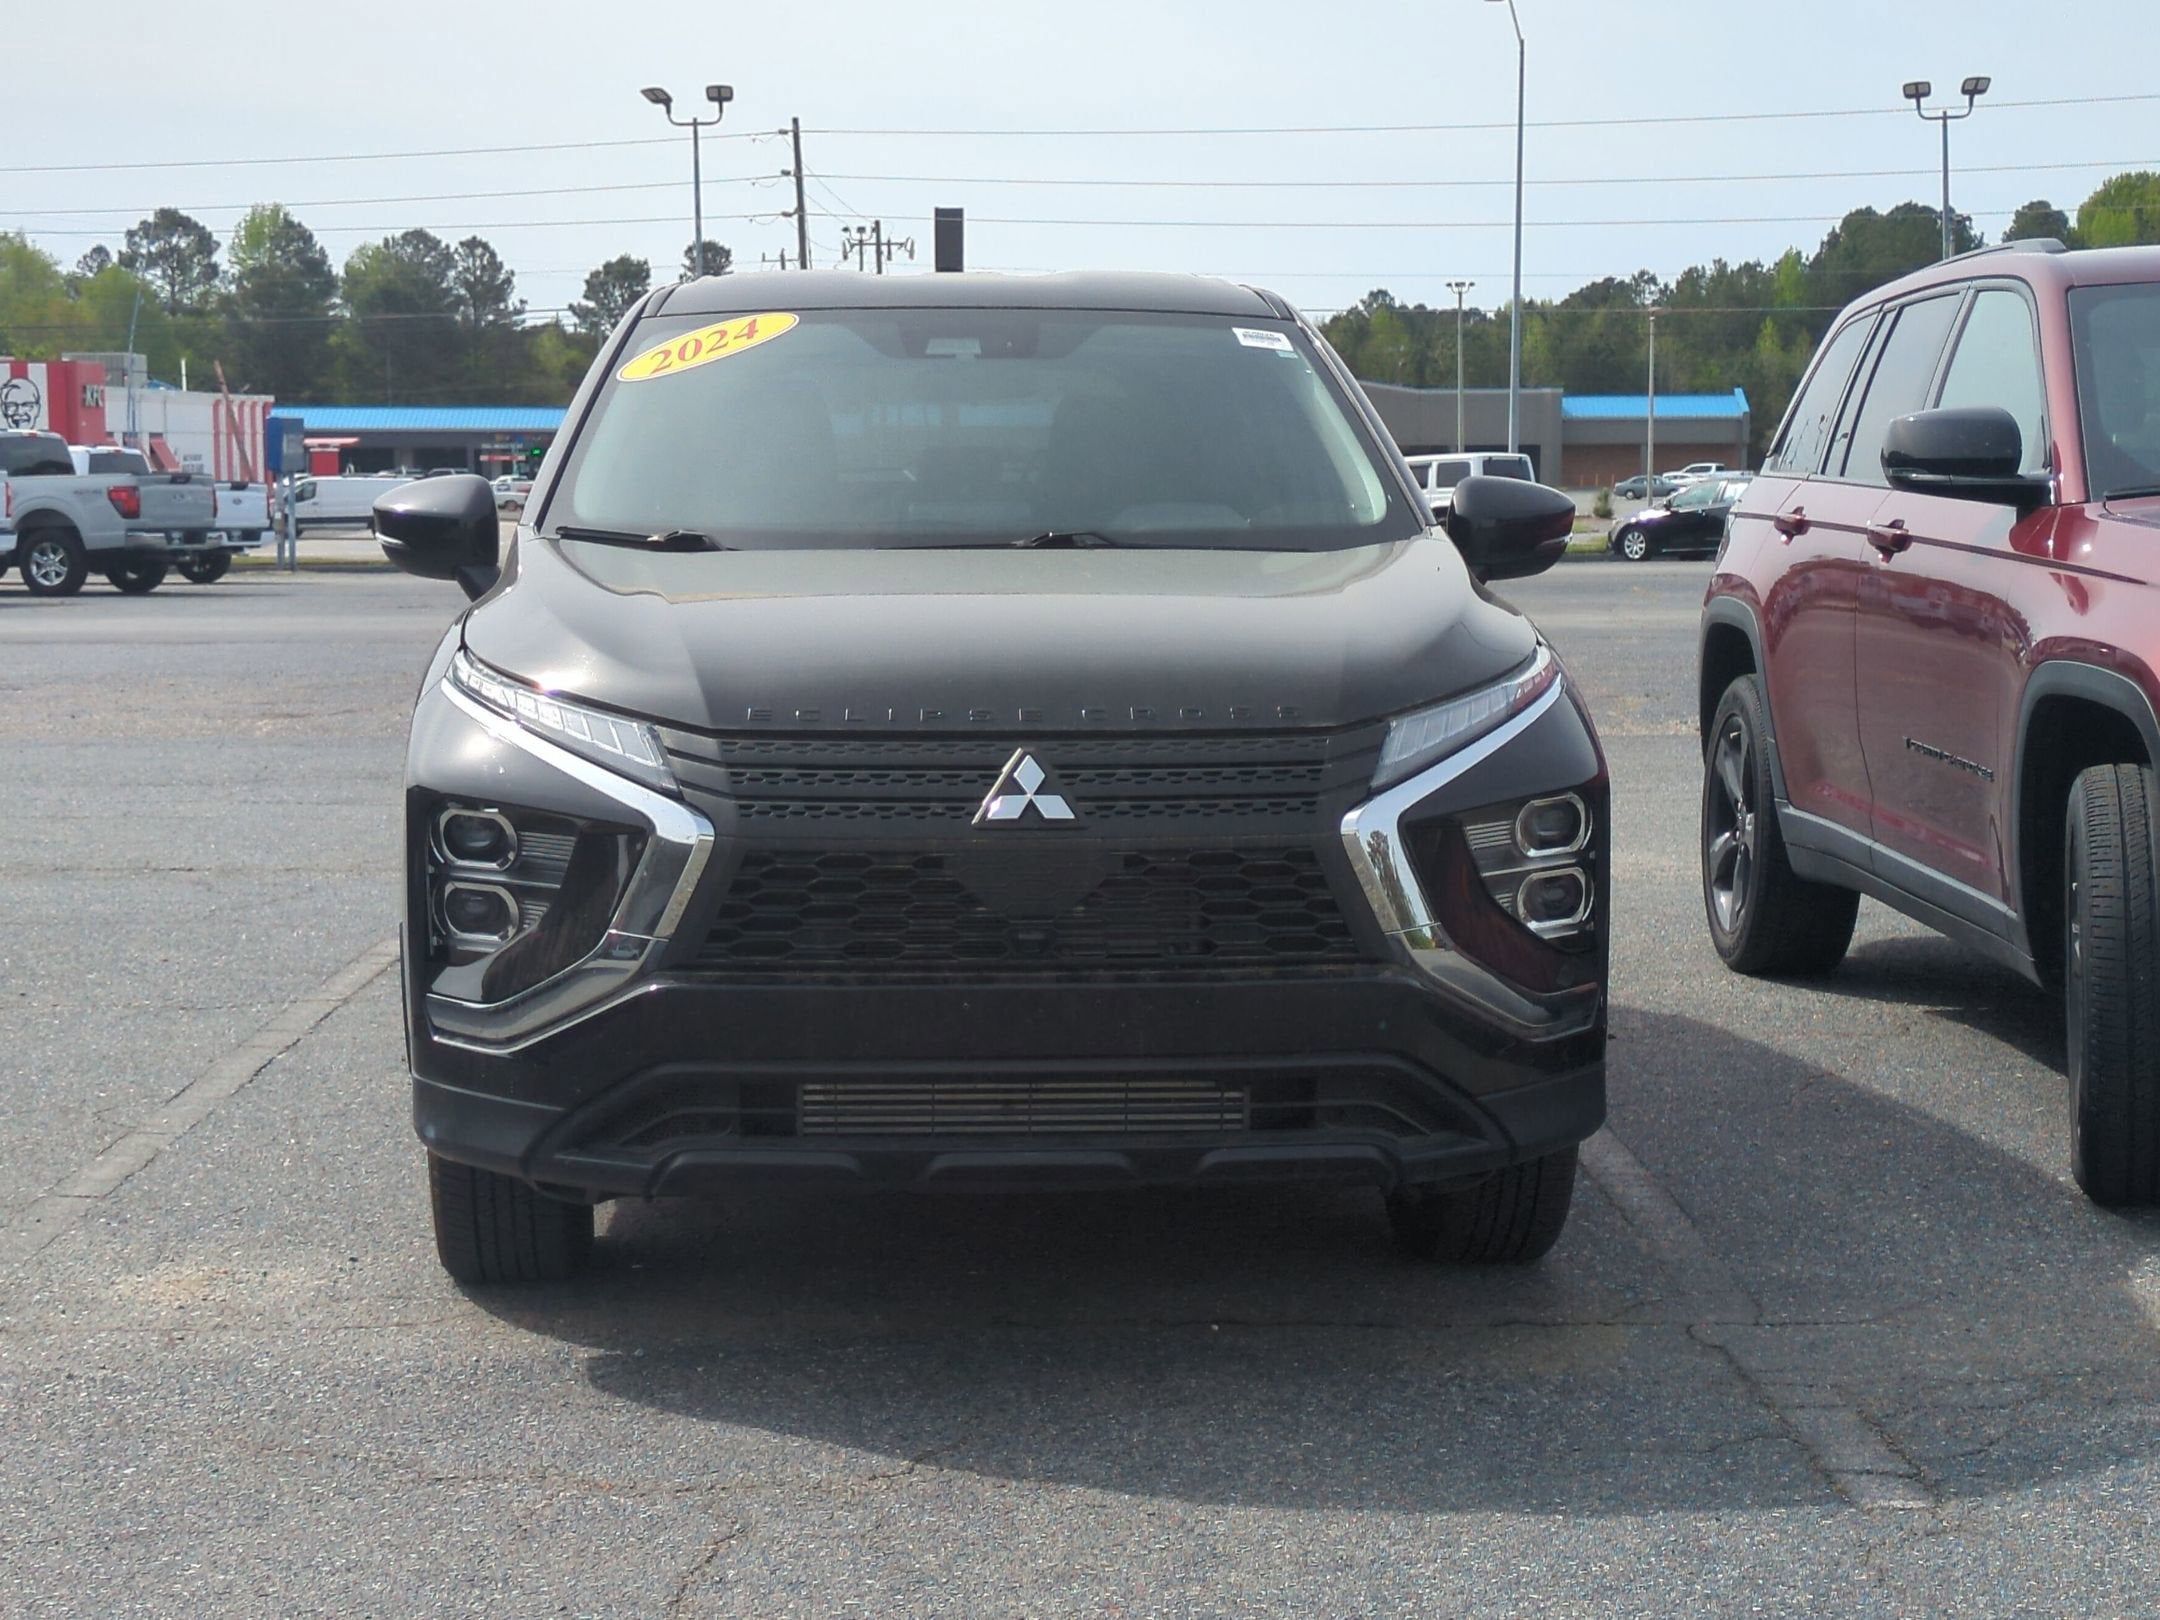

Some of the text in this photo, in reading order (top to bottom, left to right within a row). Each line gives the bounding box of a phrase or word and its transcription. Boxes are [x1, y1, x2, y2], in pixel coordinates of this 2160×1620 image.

[650, 318, 759, 375] 2024
[83, 384, 104, 408] KFC
[746, 705, 1301, 723] ECLIPSE CROSS
